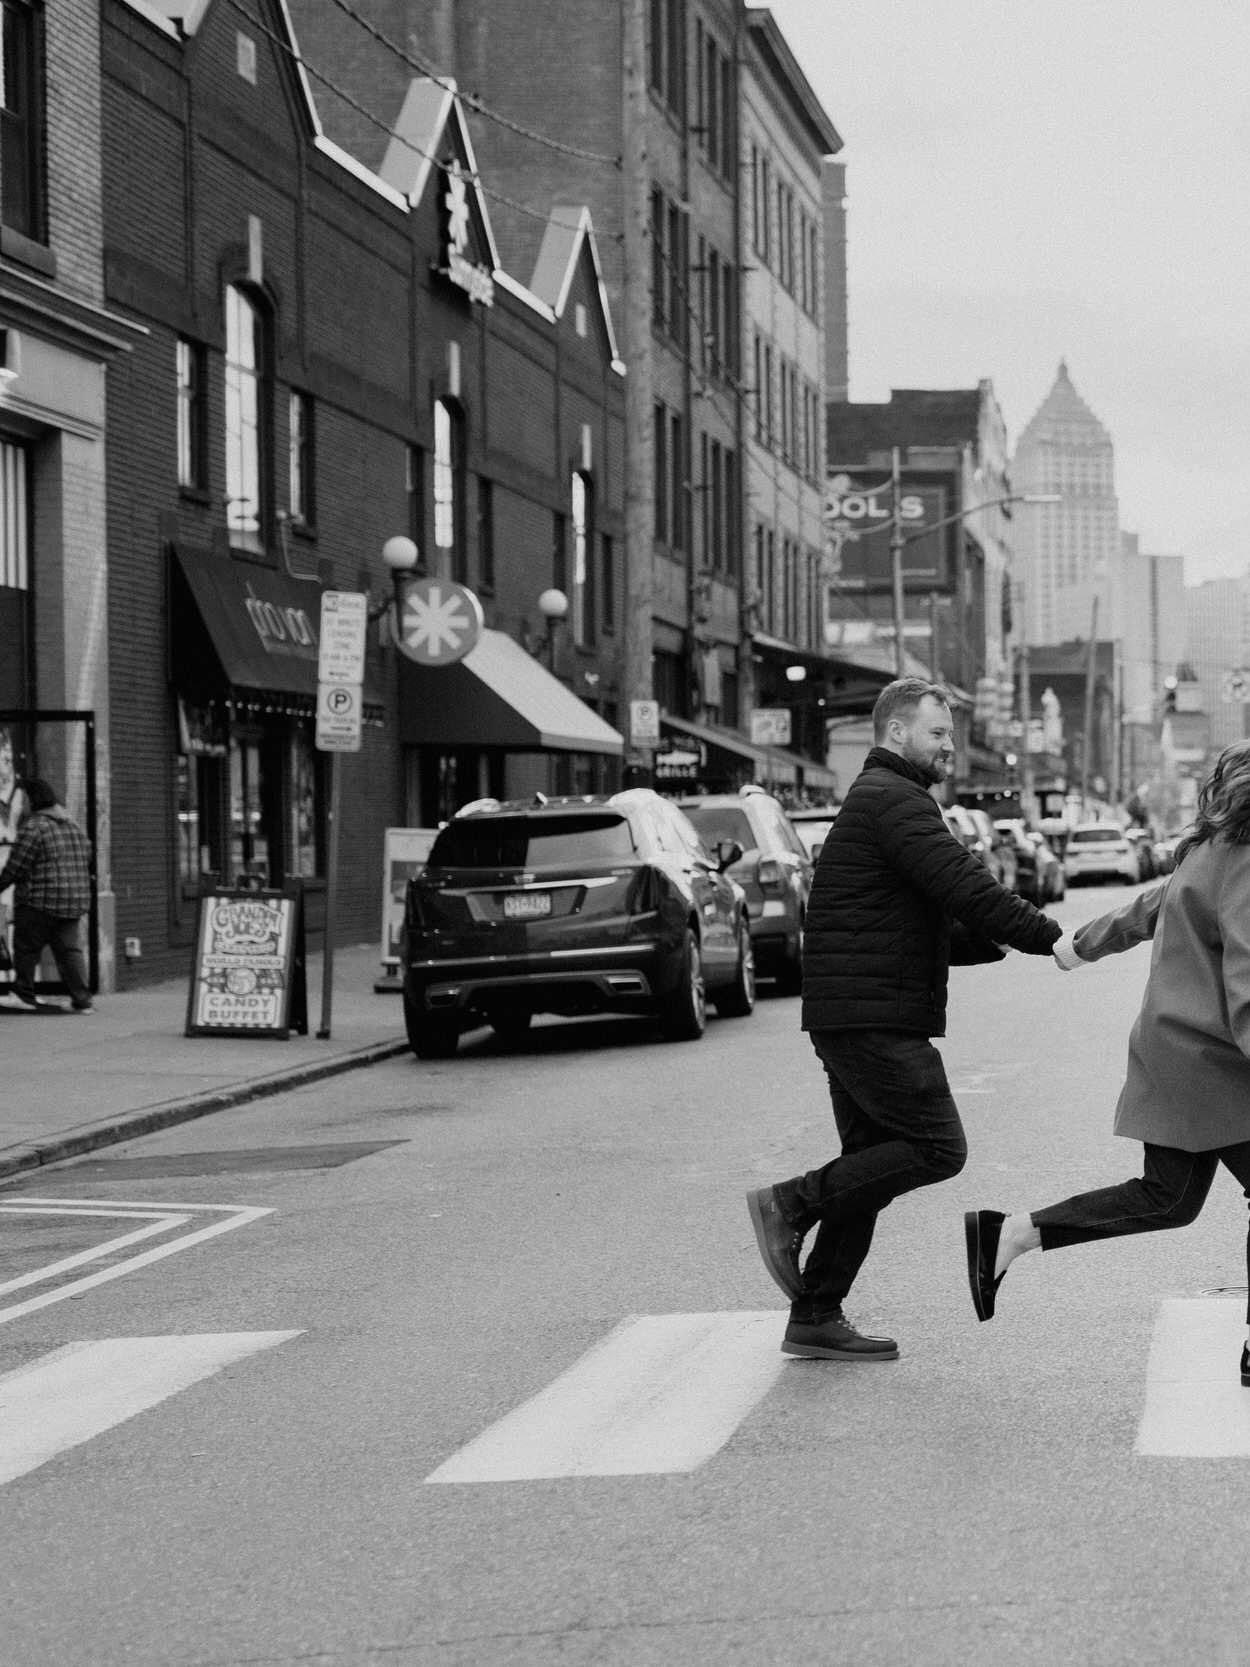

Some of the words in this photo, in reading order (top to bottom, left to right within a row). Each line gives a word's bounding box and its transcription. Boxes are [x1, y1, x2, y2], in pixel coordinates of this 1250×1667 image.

[335, 693, 347, 709] P
[208, 997, 271, 1008] CANDY
[208, 1009, 271, 1021] BUFFET
